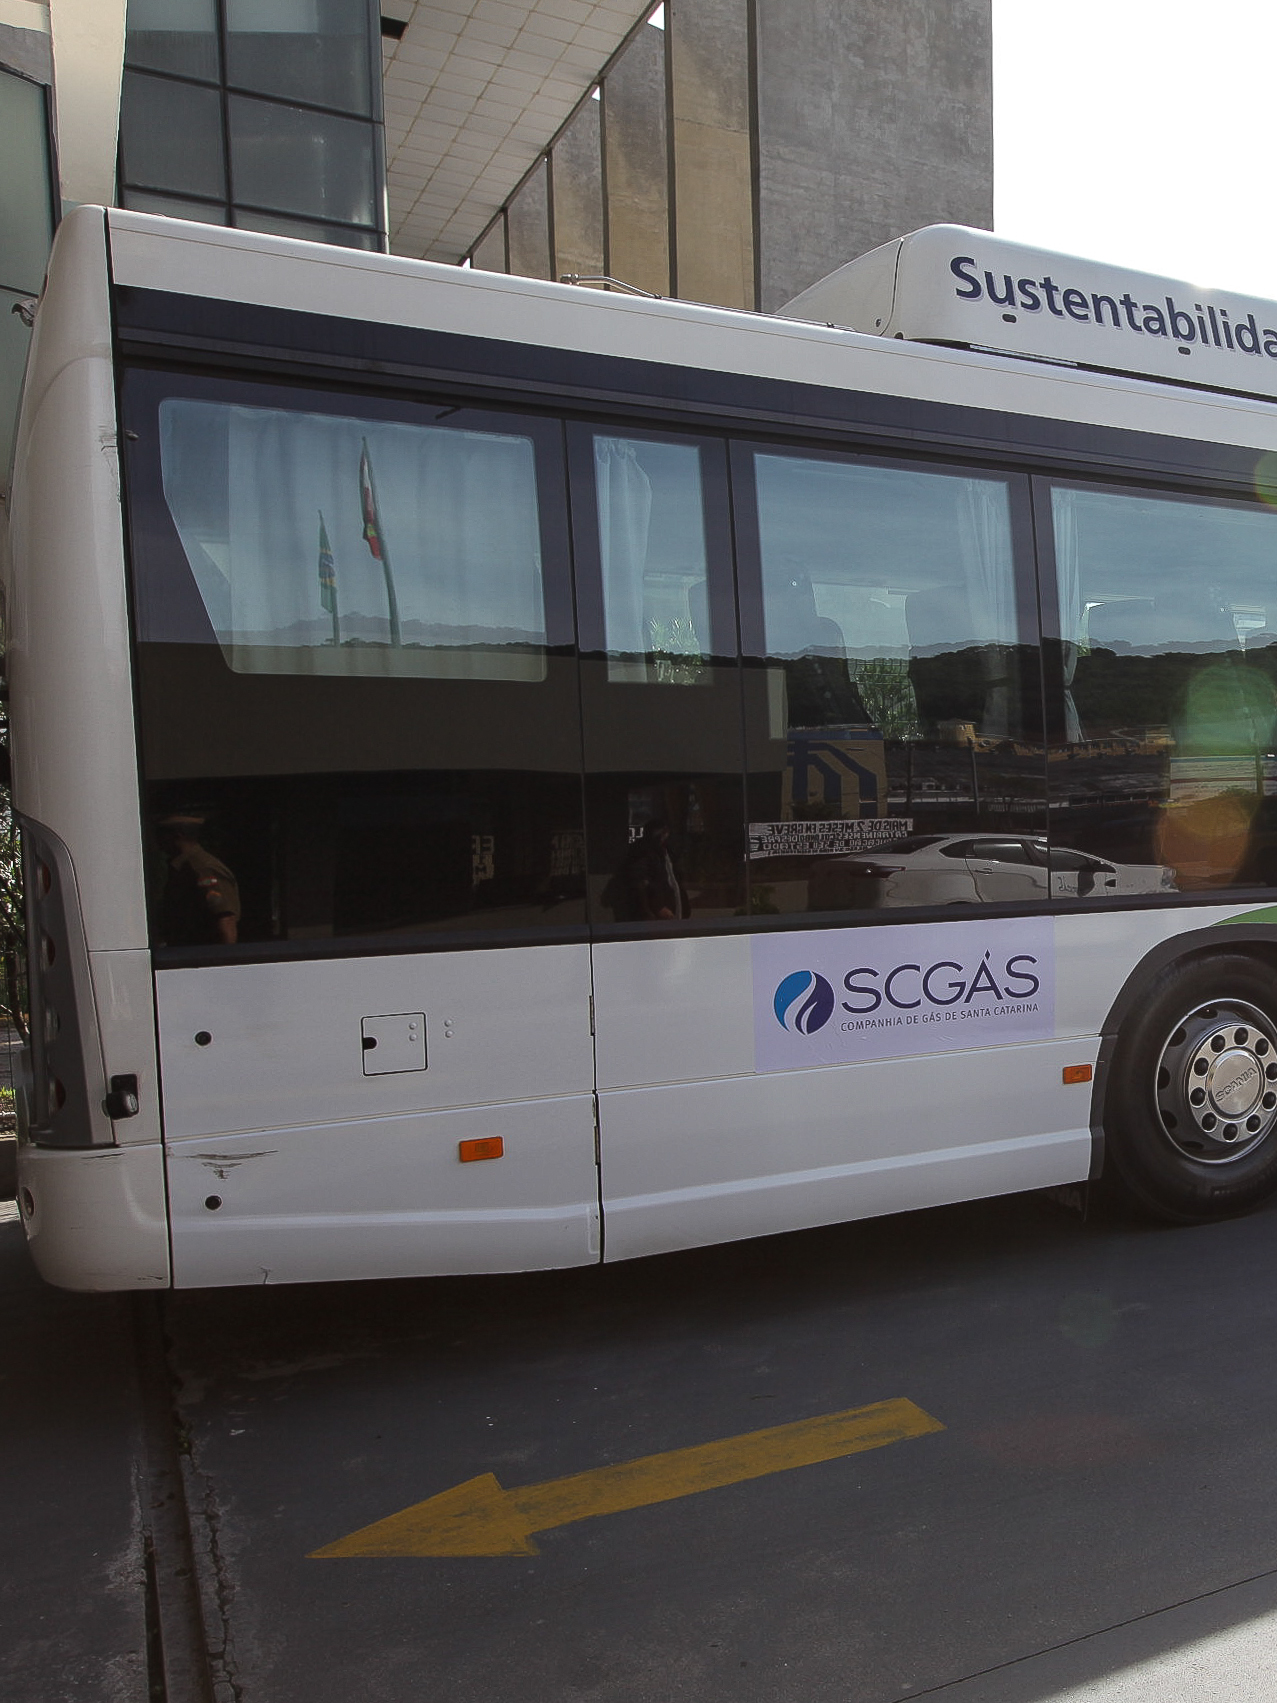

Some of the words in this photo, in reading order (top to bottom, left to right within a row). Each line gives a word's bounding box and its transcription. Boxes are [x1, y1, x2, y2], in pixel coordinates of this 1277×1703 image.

[841, 949, 1040, 1014] SCGÁS
[840, 1016, 902, 1032] COMPANHIA
[906, 1015, 919, 1025] DE
[922, 1010, 942, 1023] GÁS
[945, 1010, 958, 1021] DE
[961, 1008, 991, 1019] SANTA
[994, 1003, 1039, 1016] CATARINA
[1215, 1067, 1258, 1102] SCANIA
